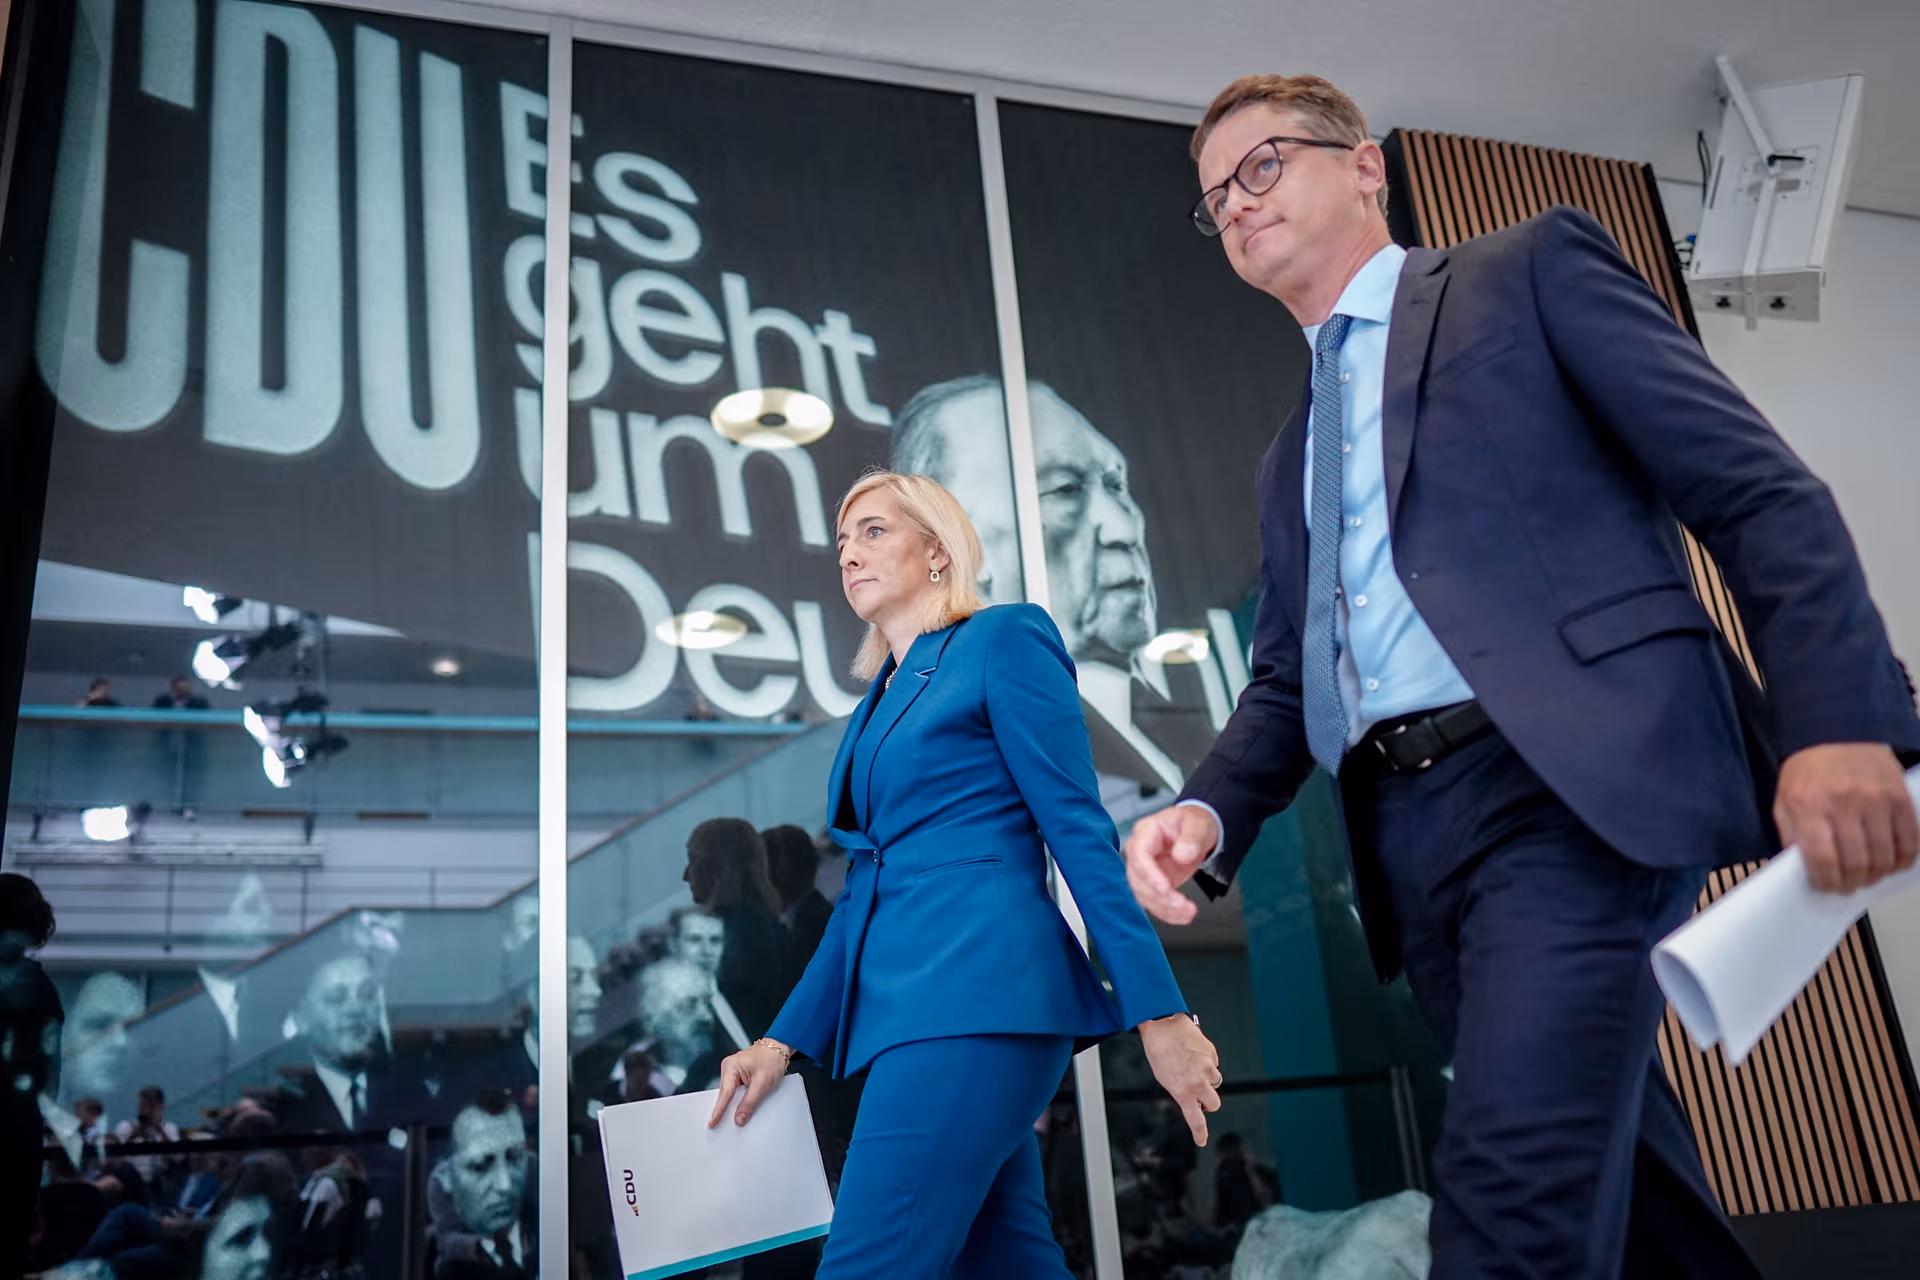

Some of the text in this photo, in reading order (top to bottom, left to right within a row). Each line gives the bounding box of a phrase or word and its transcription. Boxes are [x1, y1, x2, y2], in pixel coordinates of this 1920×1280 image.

[35, 0, 481, 490] CDU
[500, 80, 703, 263] Es
[503, 234, 893, 427] geht
[513, 387, 830, 546] um
[623, 1169, 636, 1205] CDU
